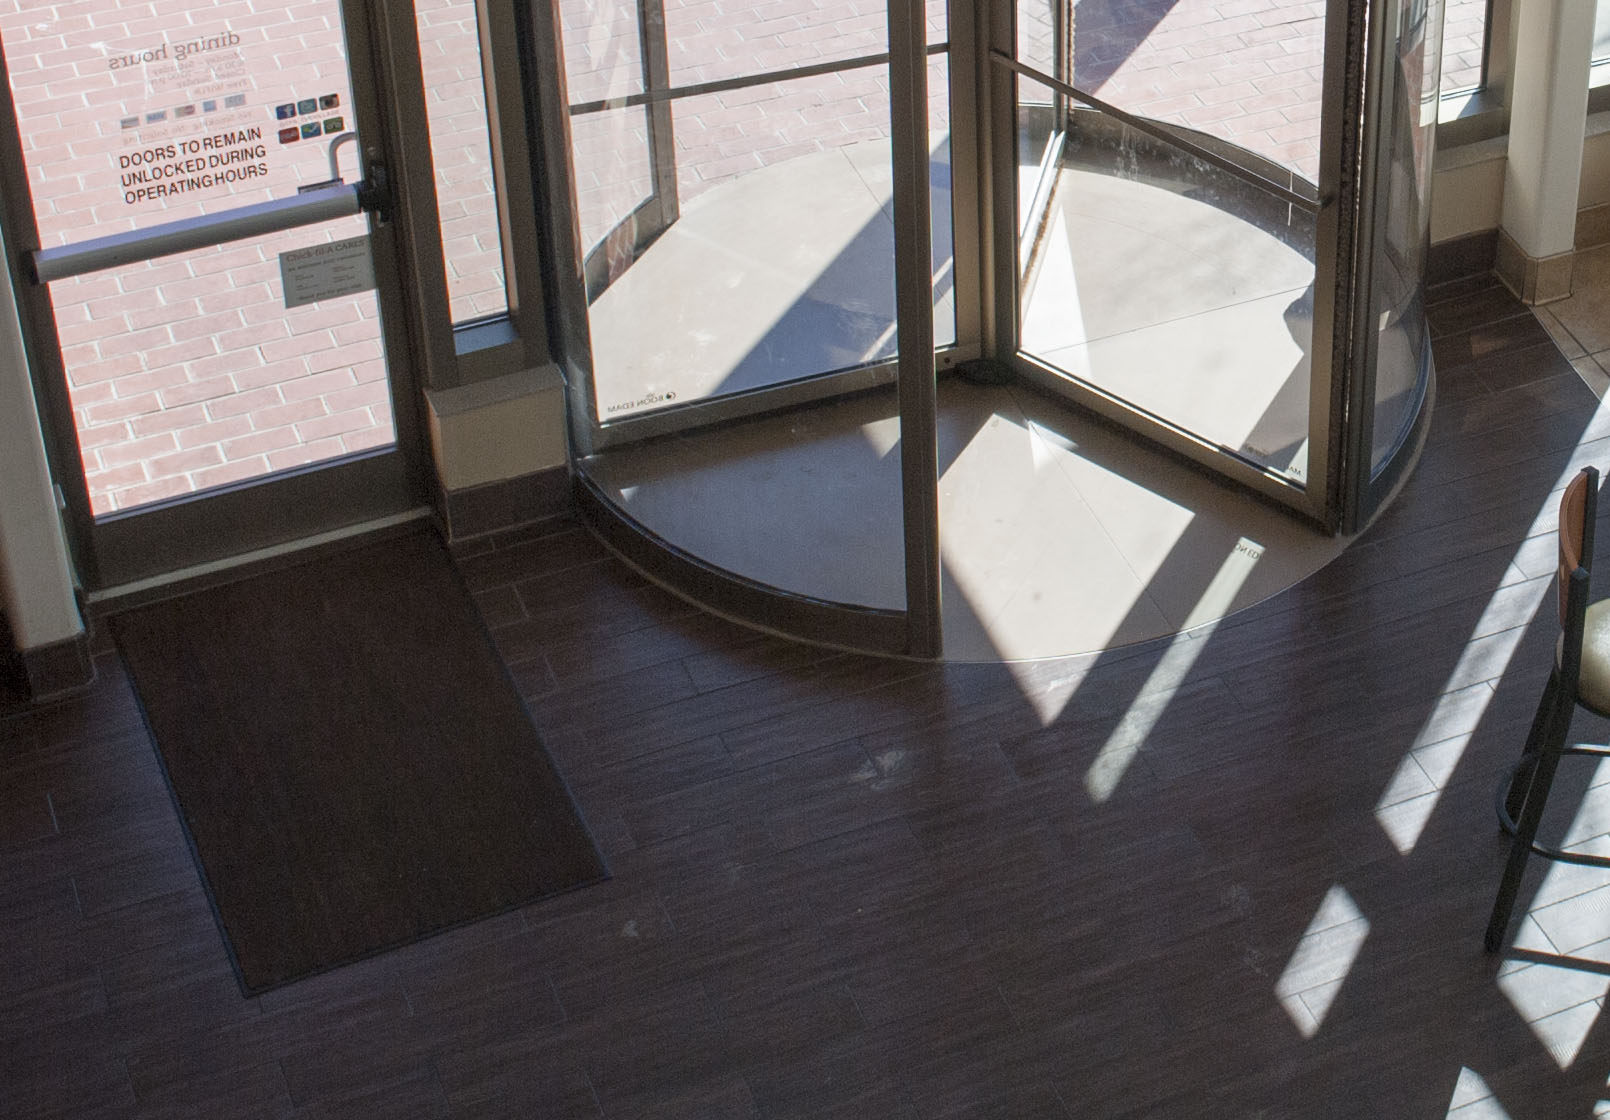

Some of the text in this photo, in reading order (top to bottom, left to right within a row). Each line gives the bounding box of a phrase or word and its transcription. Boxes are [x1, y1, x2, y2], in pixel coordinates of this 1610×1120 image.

[119, 145, 176, 169] DOORS
[179, 140, 200, 155] TO
[203, 127, 262, 150] REMAIN
[121, 145, 266, 187] UNLOCKED DURING
[125, 163, 268, 204] OPERATING HOURS
